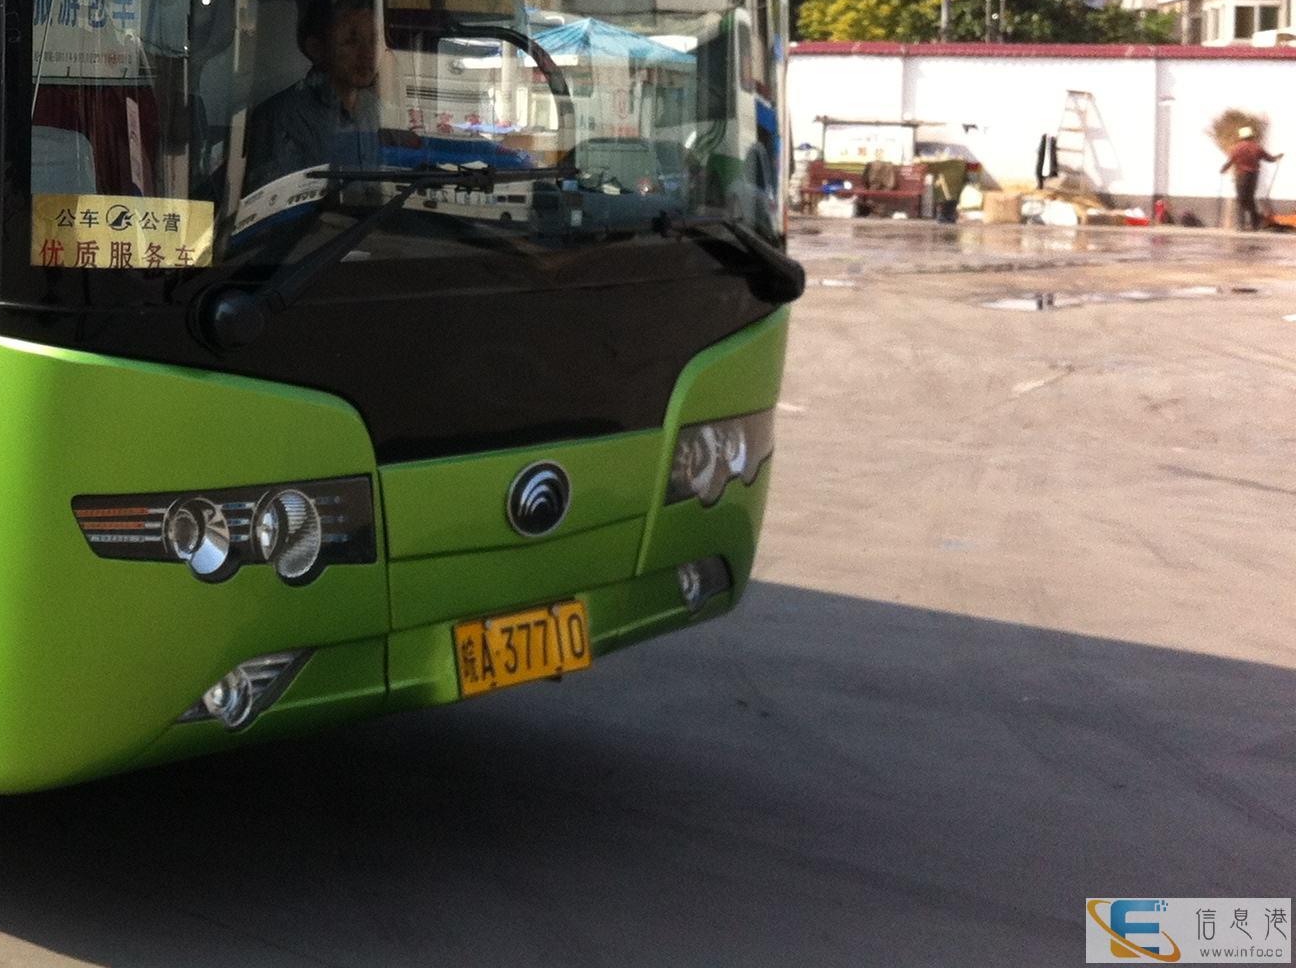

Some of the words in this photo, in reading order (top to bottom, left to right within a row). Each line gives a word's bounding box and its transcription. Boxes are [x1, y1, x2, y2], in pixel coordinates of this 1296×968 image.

[56, 208, 99, 229] 公车
[139, 210, 181, 232] 公营
[38, 238, 196, 268] 优质服务车
